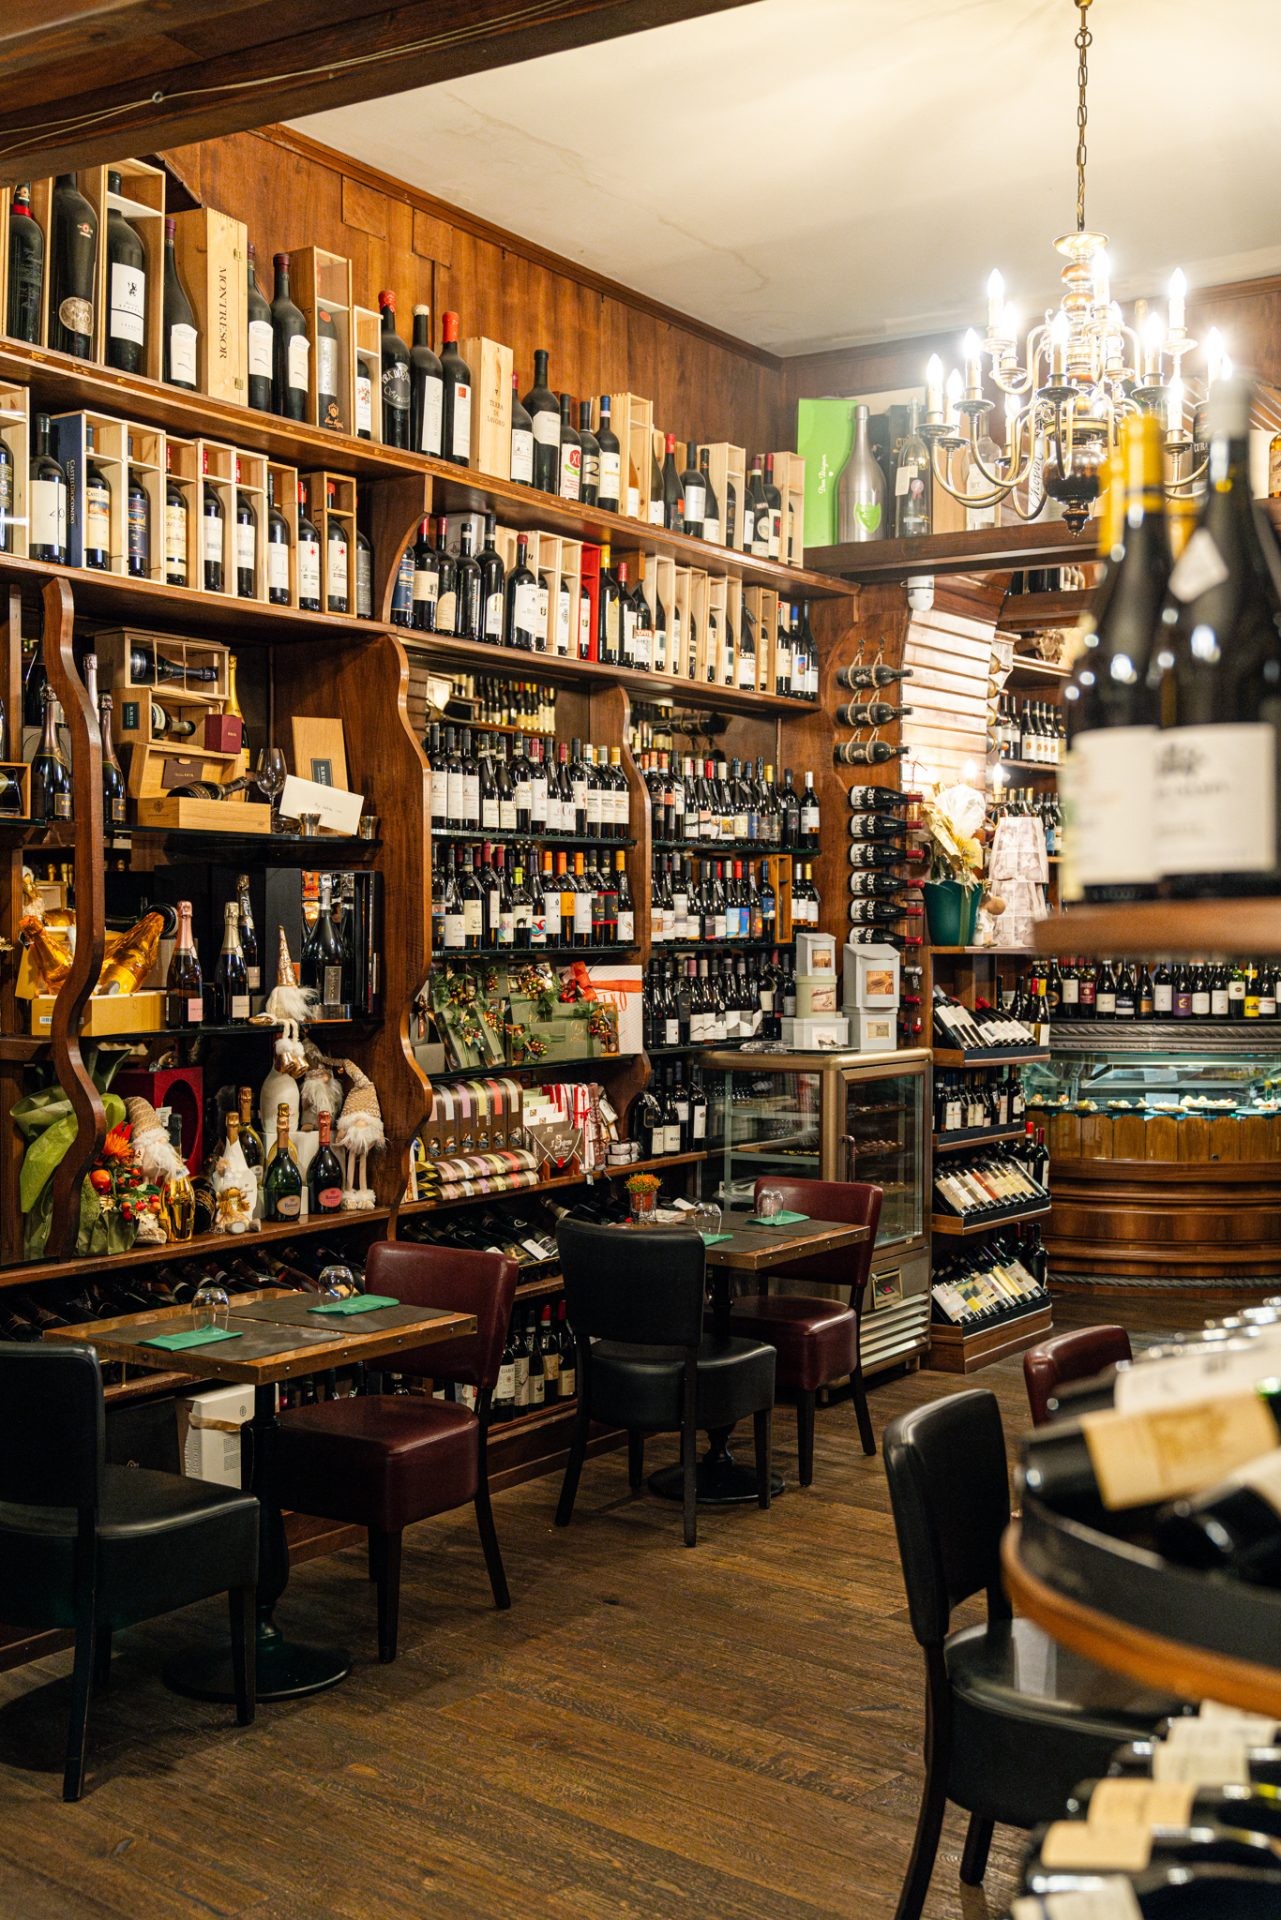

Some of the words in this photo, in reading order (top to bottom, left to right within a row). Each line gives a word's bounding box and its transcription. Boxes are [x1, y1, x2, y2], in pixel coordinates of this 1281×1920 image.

[218, 266, 228, 360] MONTRESOR
[584, 461, 599, 477] 2
[867, 788, 875, 808] 201
[864, 928, 873, 944] 201
